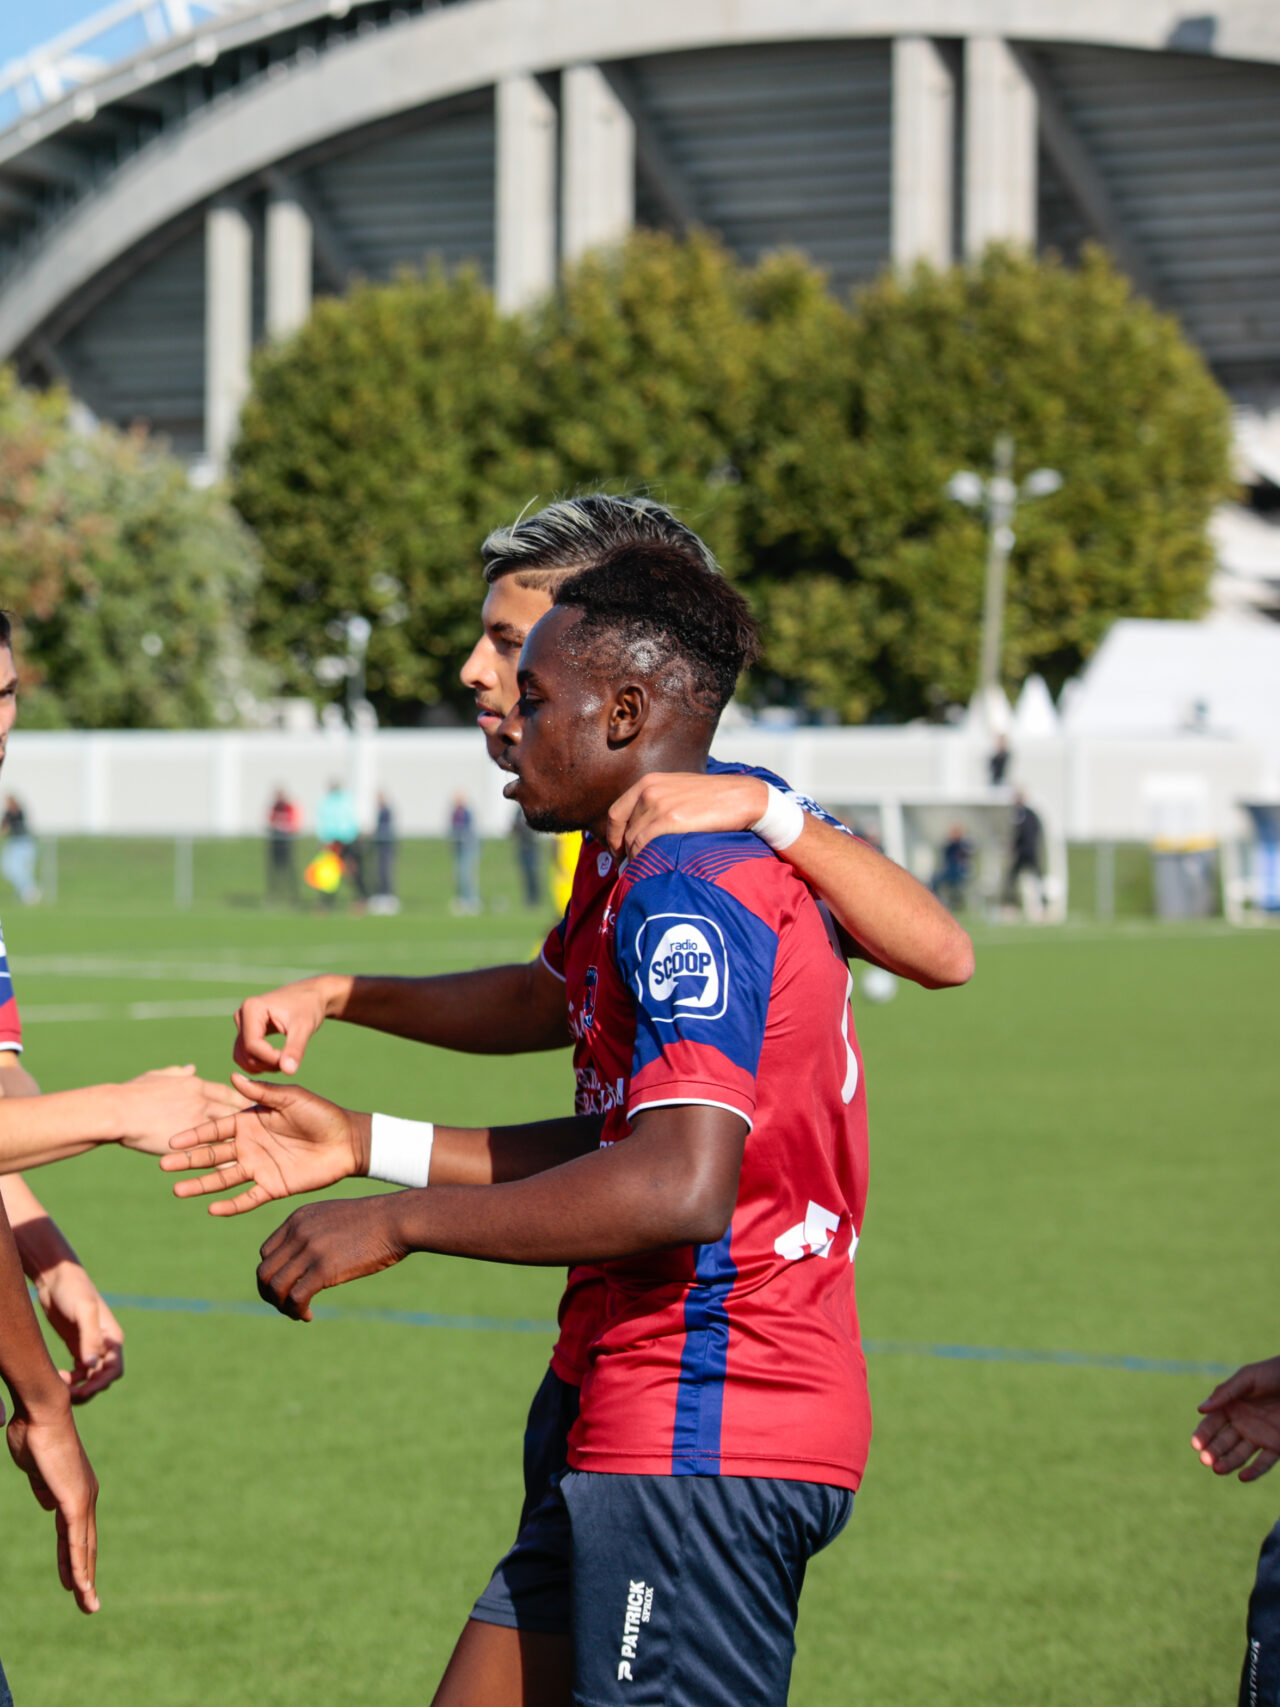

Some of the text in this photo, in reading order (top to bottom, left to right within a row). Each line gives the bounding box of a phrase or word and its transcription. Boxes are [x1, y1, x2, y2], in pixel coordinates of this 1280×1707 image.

[670, 939, 698, 952] radio
[651, 951, 712, 986] SCOOP
[621, 1579, 646, 1659] PATRICK
